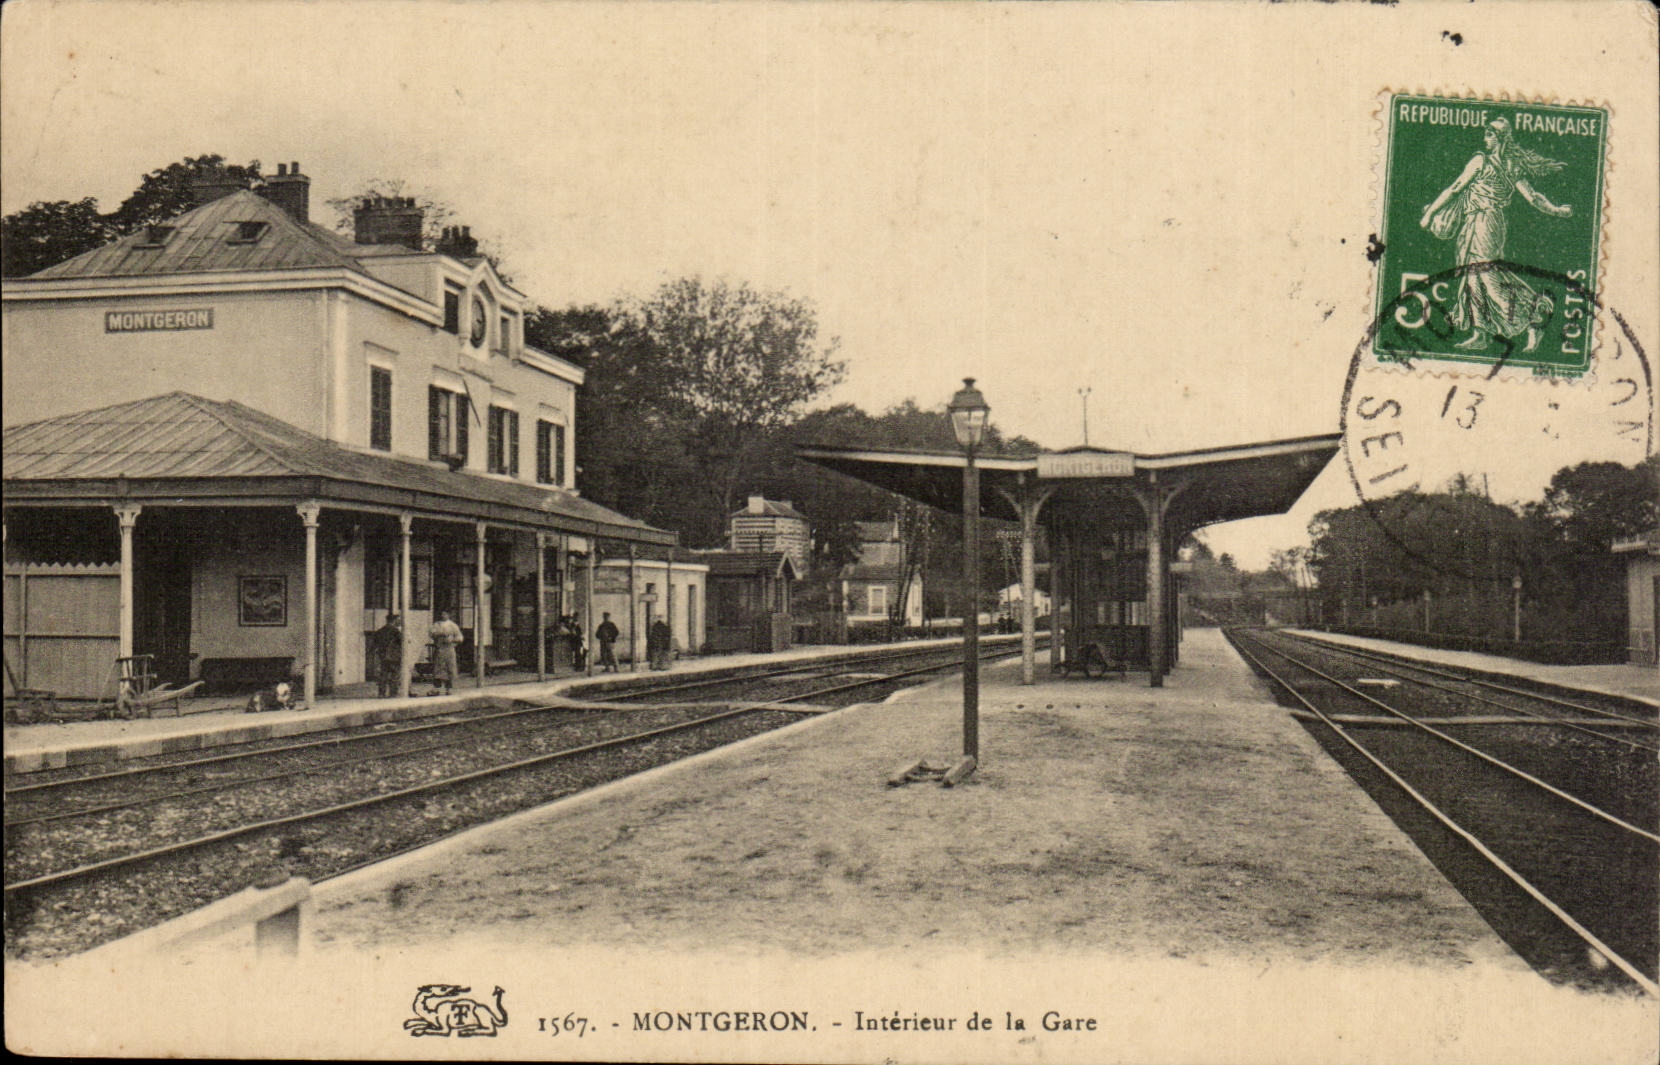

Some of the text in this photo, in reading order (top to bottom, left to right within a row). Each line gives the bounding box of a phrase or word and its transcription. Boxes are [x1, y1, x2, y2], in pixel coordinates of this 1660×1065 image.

[1399, 103, 1598, 137] REPUBLIQUE FRANÇAISE
[108, 310, 209, 330] MONTGERON
[1441, 385, 1486, 430] 13
